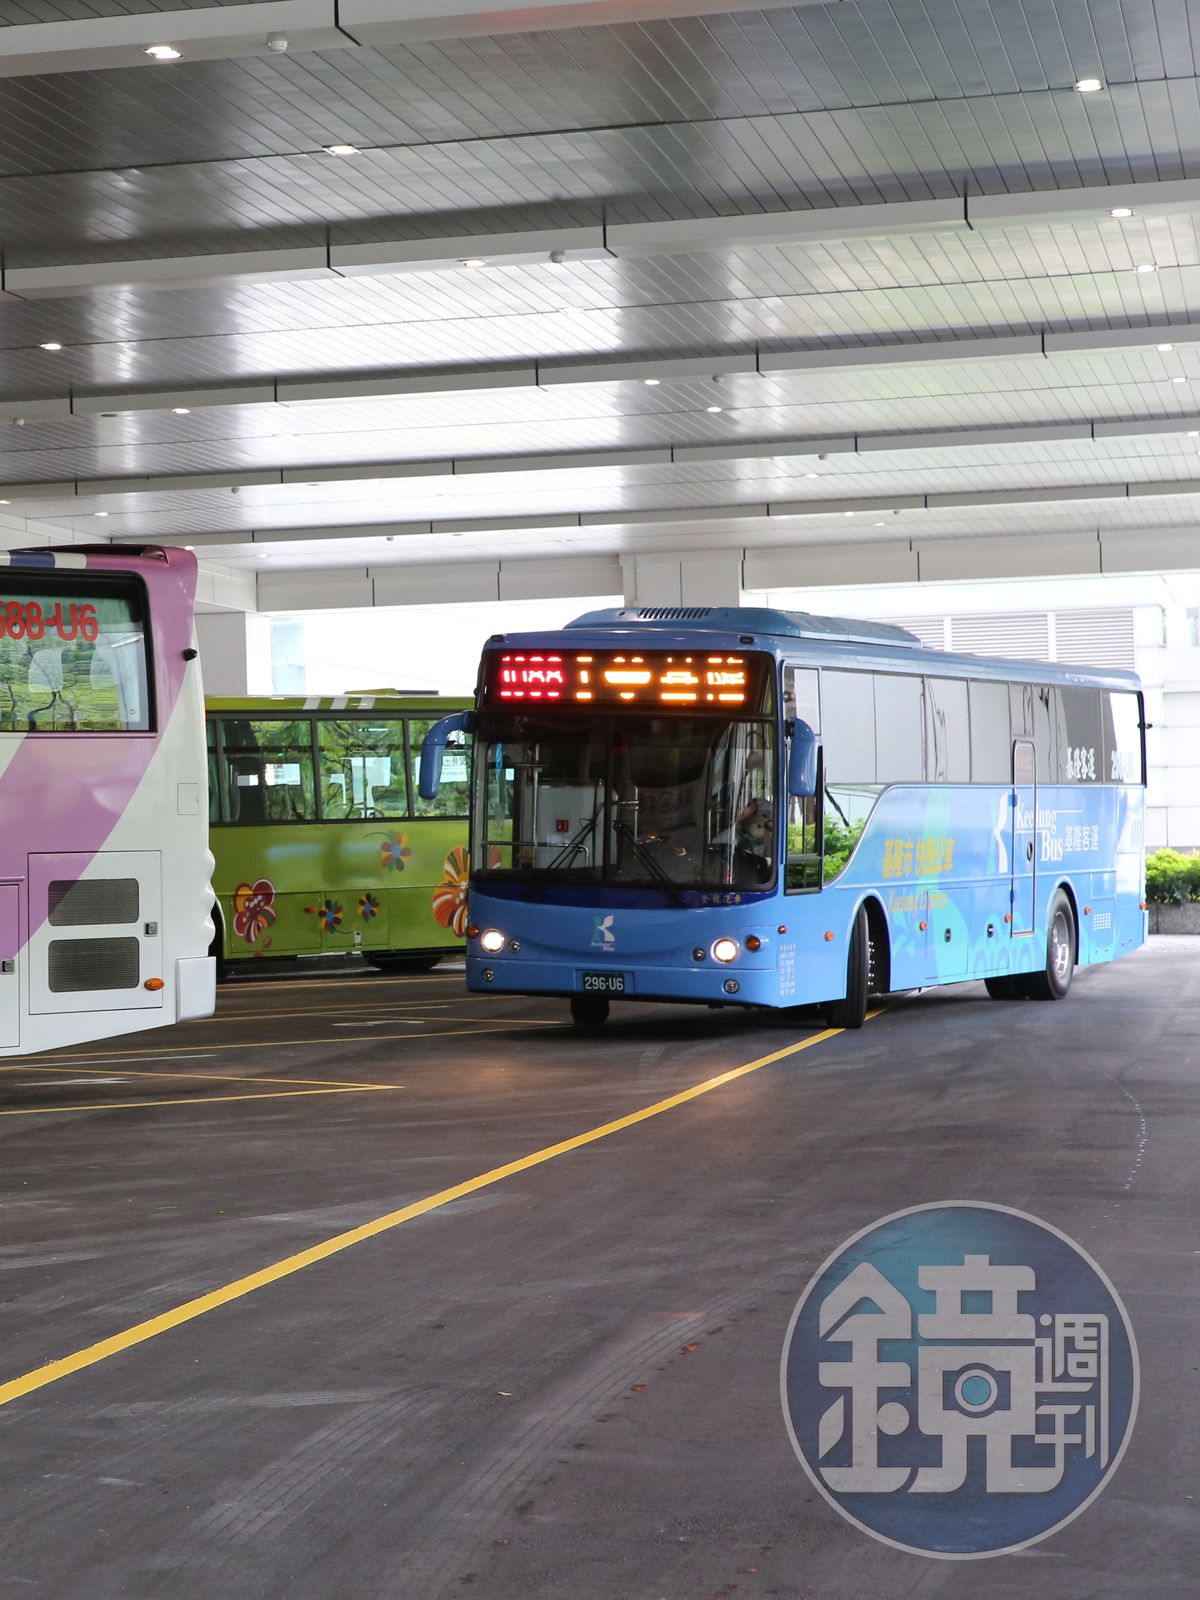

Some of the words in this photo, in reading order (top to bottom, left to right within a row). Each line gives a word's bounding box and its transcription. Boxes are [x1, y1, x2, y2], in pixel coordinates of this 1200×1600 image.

[1015, 800, 1057, 834] Keelung
[1041, 830, 1063, 861] Bus
[1065, 826, 1099, 852] 基隆客運
[585, 976, 624, 991] 296-U6
